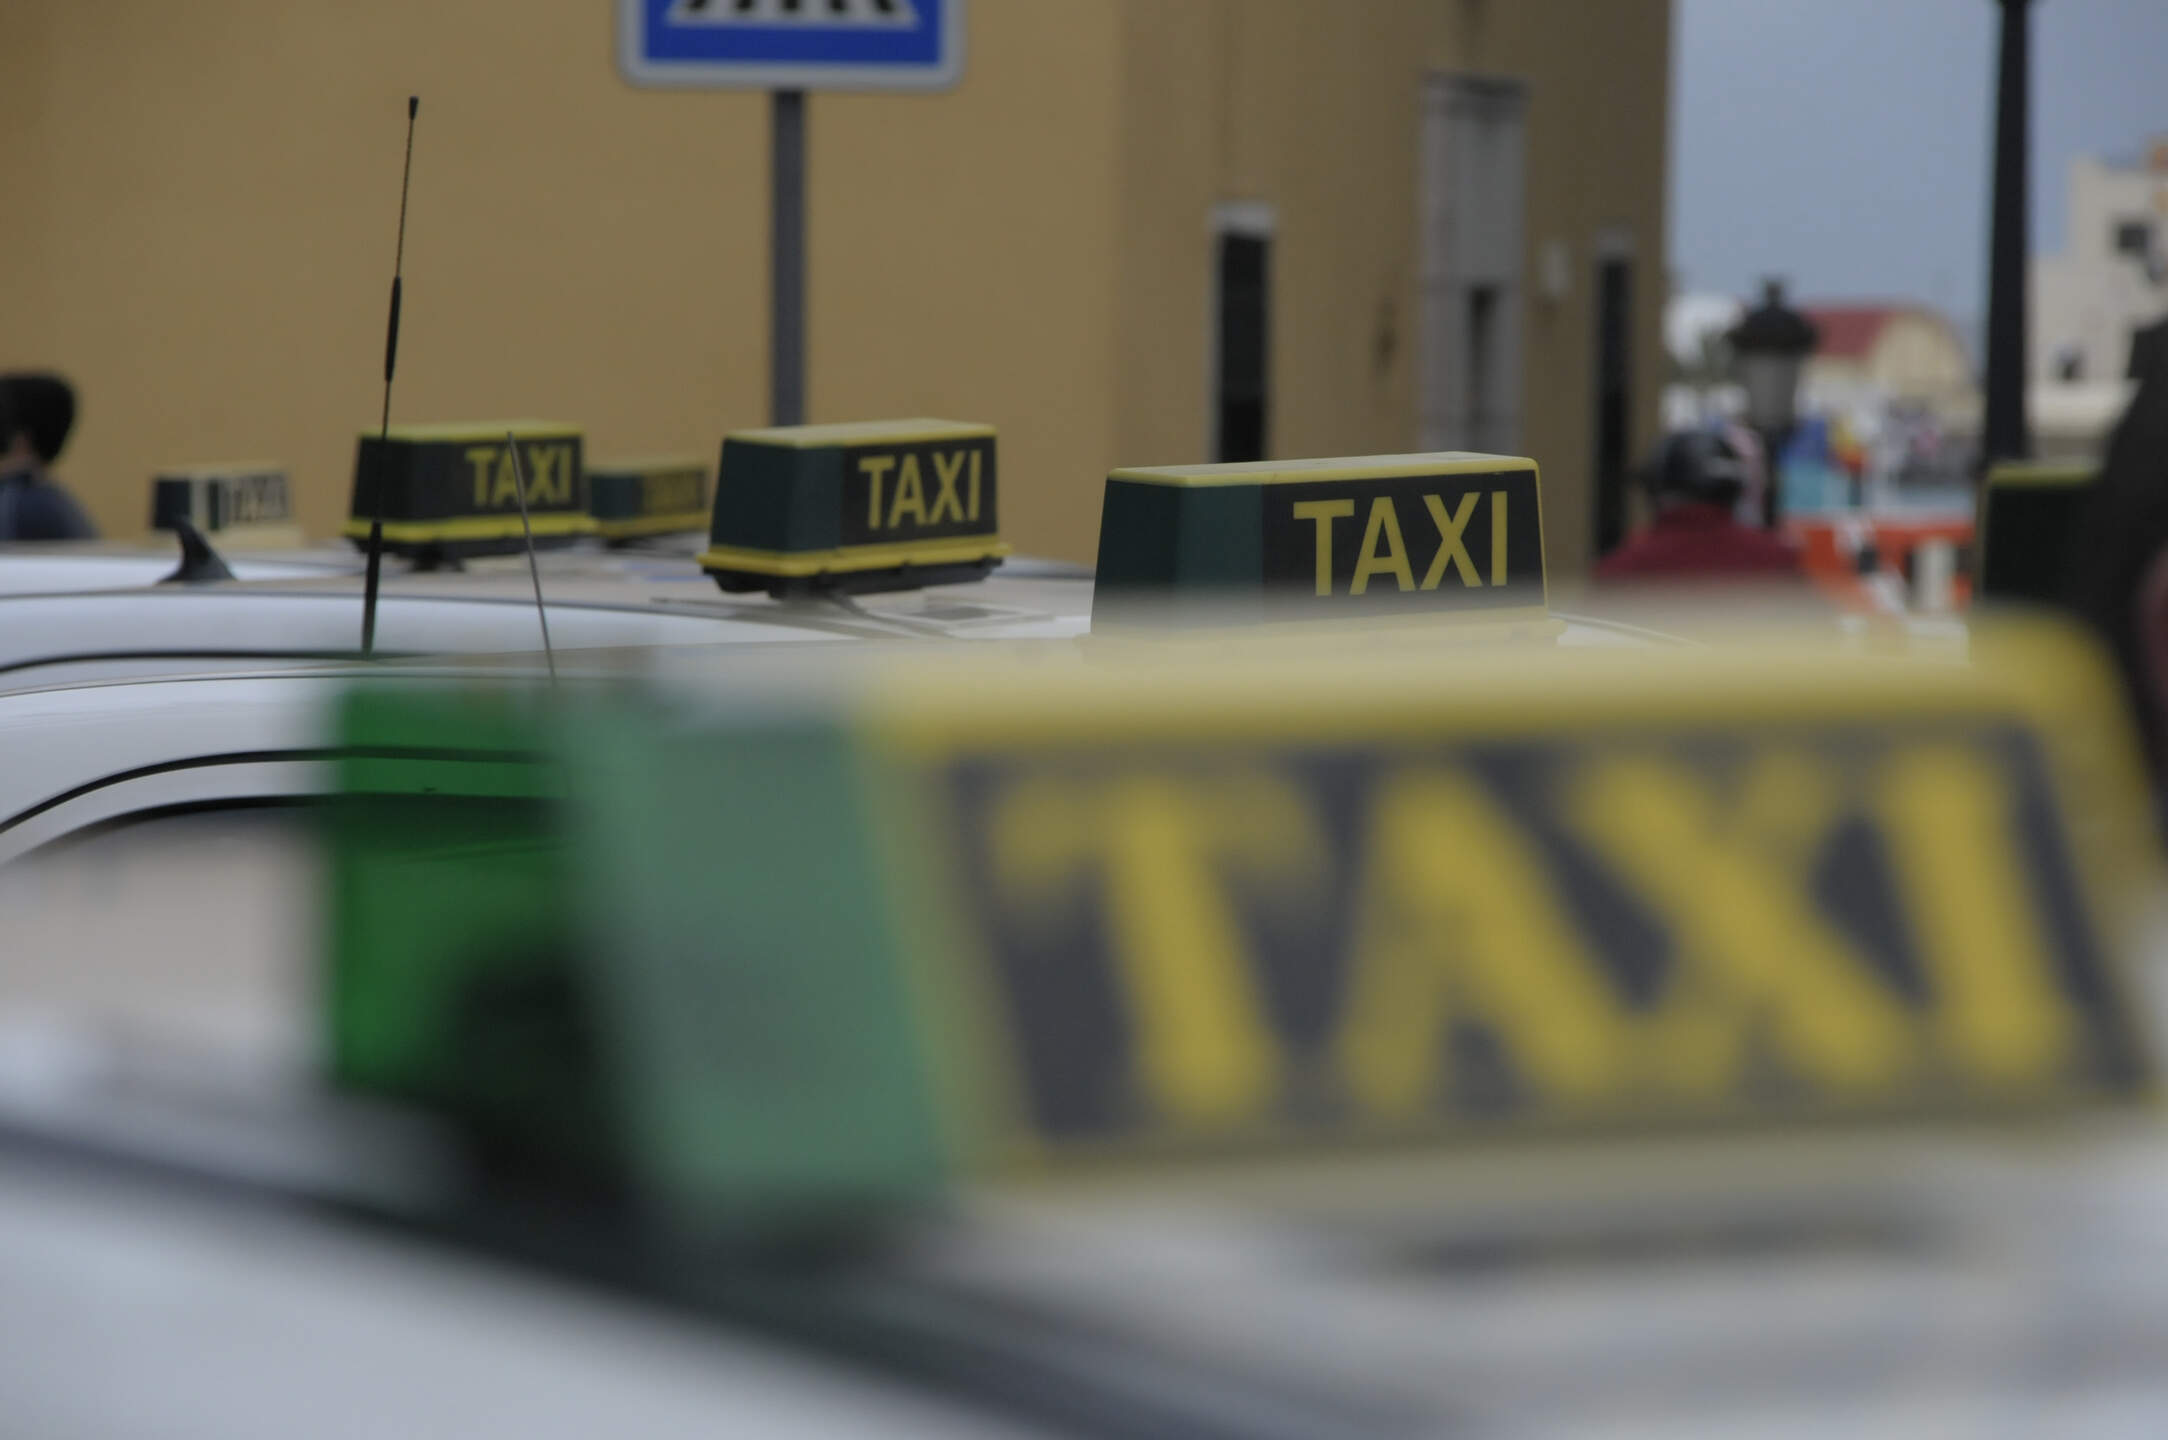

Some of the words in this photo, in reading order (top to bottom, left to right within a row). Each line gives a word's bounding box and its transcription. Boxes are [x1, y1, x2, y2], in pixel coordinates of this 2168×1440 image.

[465, 446, 571, 507] TAXI
[858, 450, 981, 530] TAXI
[1293, 491, 1508, 596] TAXI
[993, 745, 2070, 1118] TAXI
